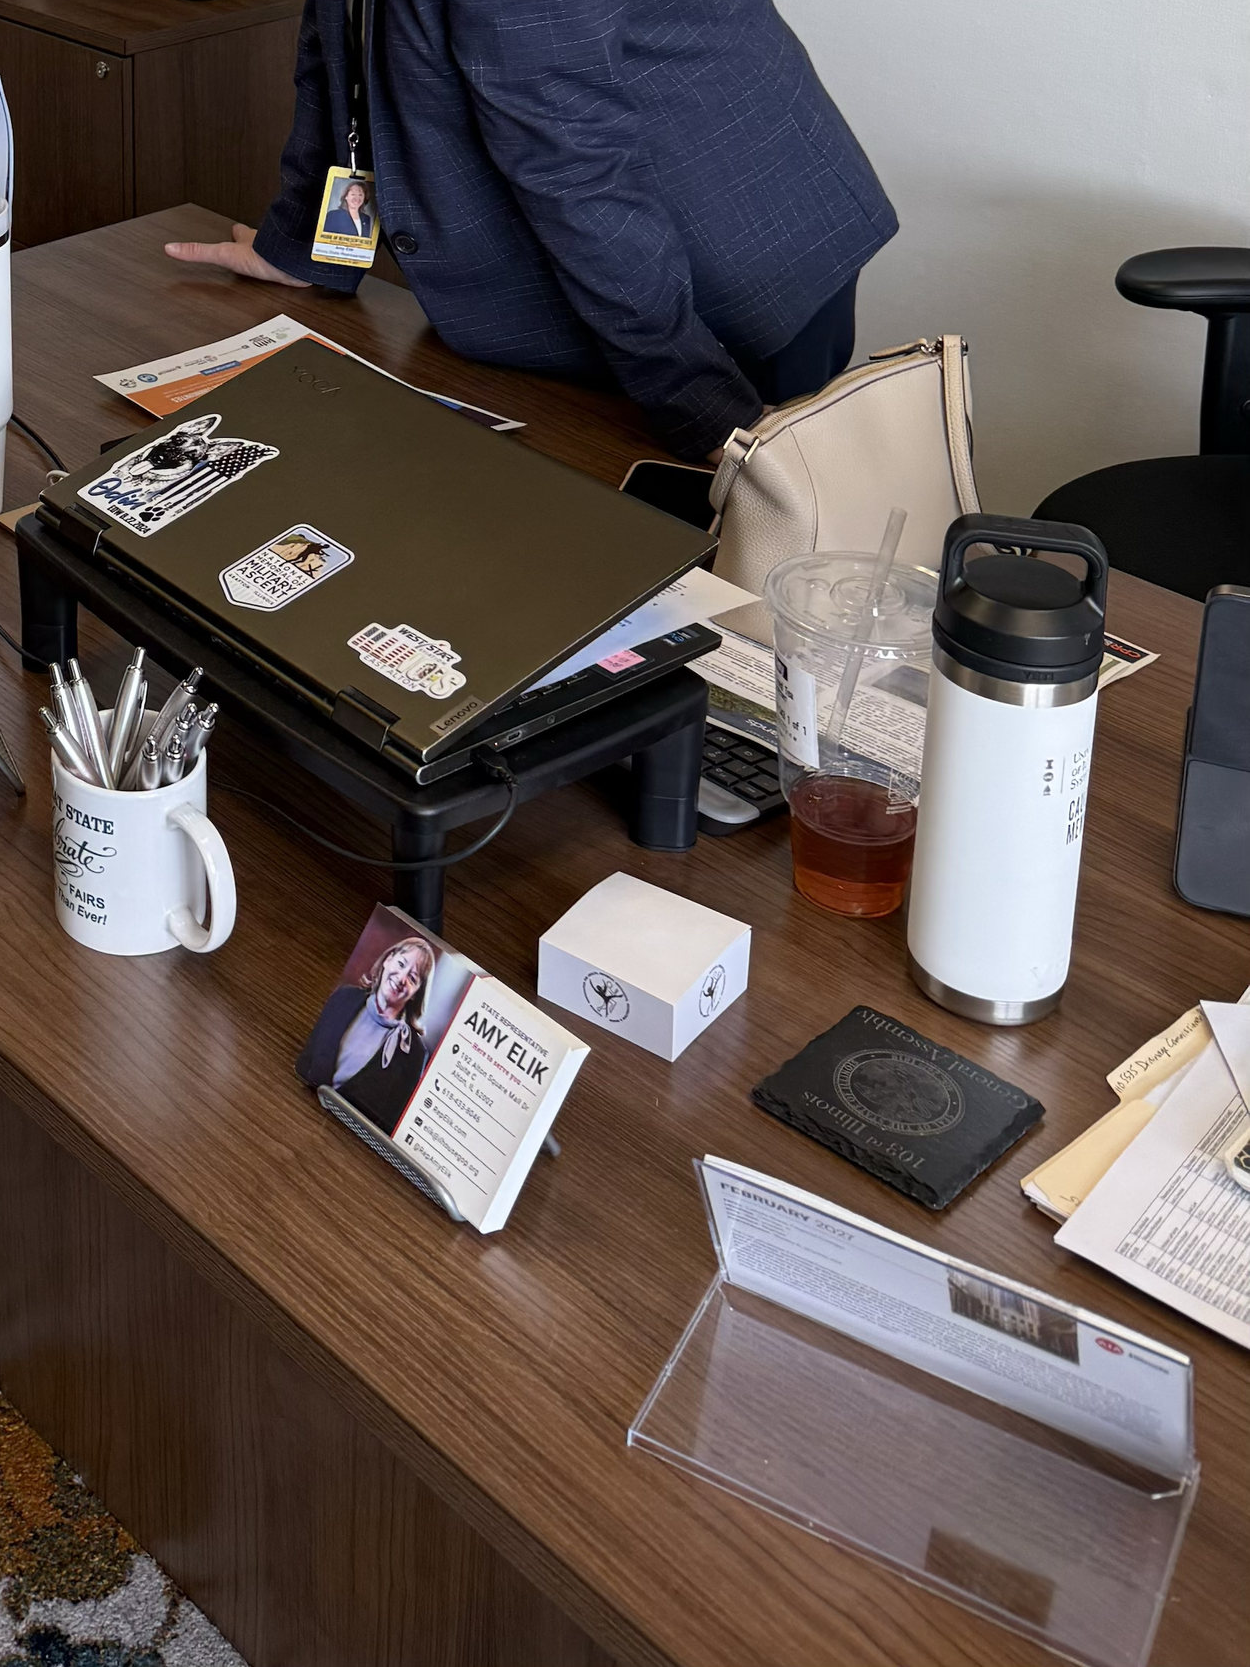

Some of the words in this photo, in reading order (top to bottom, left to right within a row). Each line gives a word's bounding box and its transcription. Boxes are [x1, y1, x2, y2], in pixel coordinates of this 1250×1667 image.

[87, 477, 146, 511] Odin
[237, 565, 288, 599] ASCENT
[246, 559, 297, 592] MILITARY
[255, 555, 291, 581] MEMORIAL
[292, 579, 304, 588] OF
[363, 654, 389, 670] EAST
[386, 669, 417, 690] ALTON
[435, 700, 478, 732] Lenovo
[65, 803, 114, 836] STATE
[57, 885, 75, 912] Than
[77, 904, 108, 926] Ever!
[480, 1001, 500, 1020] STATE
[499, 1016, 549, 1058] REPRESENTATIVE
[856, 1008, 948, 1063] Assembly
[464, 1011, 509, 1050] AMY
[506, 1042, 550, 1086] ELIK
[472, 1043, 487, 1058] Here
[486, 1054, 493, 1063] to
[493, 1060, 510, 1077] serve
[509, 1072, 522, 1086] you
[451, 1070, 468, 1088] Alton,
[467, 1083, 475, 1094] IL
[455, 1061, 471, 1077] Suite
[470, 1073, 477, 1081] C
[460, 1052, 472, 1065] 192
[472, 1061, 488, 1079] Alton
[487, 1072, 509, 1096] Square
[508, 1089, 522, 1105] Mall
[521, 1100, 530, 1112] Dr
[837, 1058, 859, 1090] ILLINOIS
[947, 1060, 1029, 1110] General
[432, 1106, 468, 1139] RepElik.com
[803, 1090, 868, 1136] Illinois
[413, 1143, 452, 1179] @RepAmyElik
[720, 1182, 812, 1223] FEBRUARY
